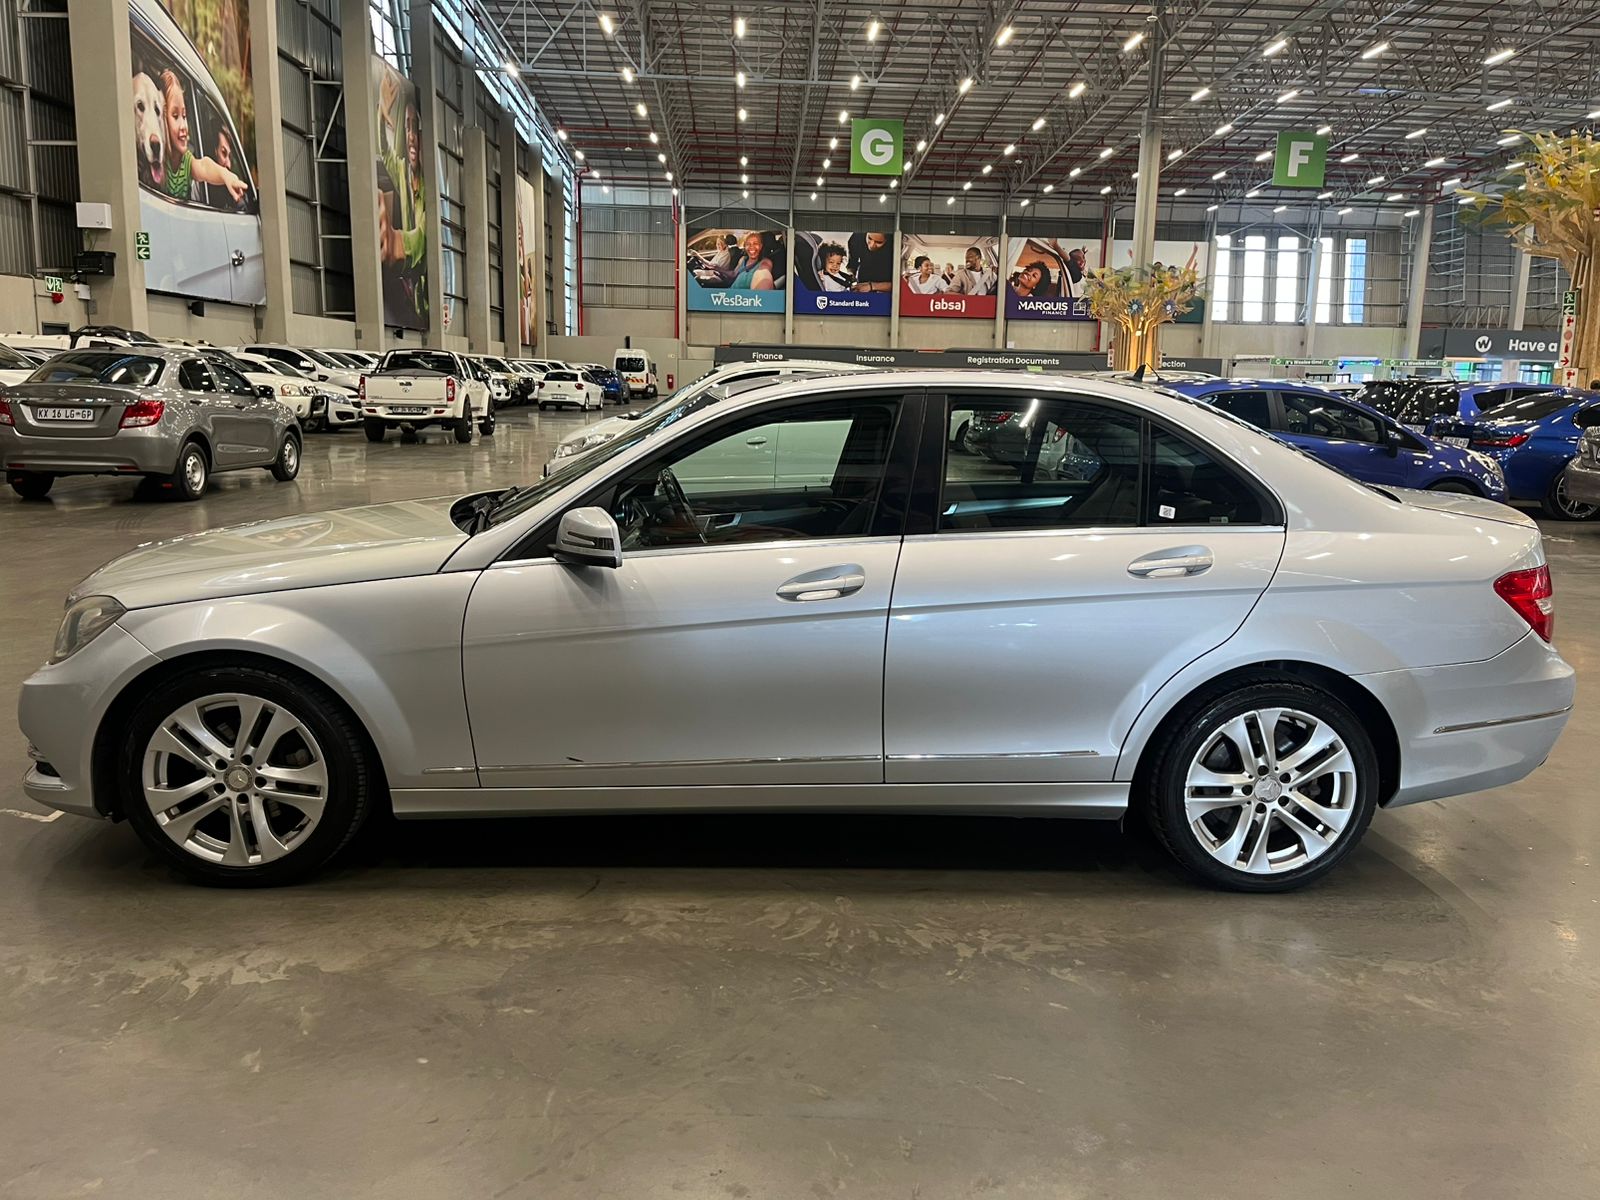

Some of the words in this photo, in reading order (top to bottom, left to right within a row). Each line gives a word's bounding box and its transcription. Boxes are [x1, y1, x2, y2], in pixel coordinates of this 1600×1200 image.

[861, 128, 894, 166] G
[1287, 141, 1314, 177] F
[711, 292, 762, 307] WesBank
[1018, 301, 1068, 311] MARQUIS
[1508, 339, 1546, 352] Have
[1548, 342, 1558, 352] a
[752, 352, 783, 360] Finance
[856, 354, 895, 363] Insurance
[967, 356, 1014, 365] Registration
[1016, 357, 1060, 366] Documents
[1162, 360, 1186, 368] ection
[38, 409, 48, 418] KX
[52, 409, 61, 418] 16
